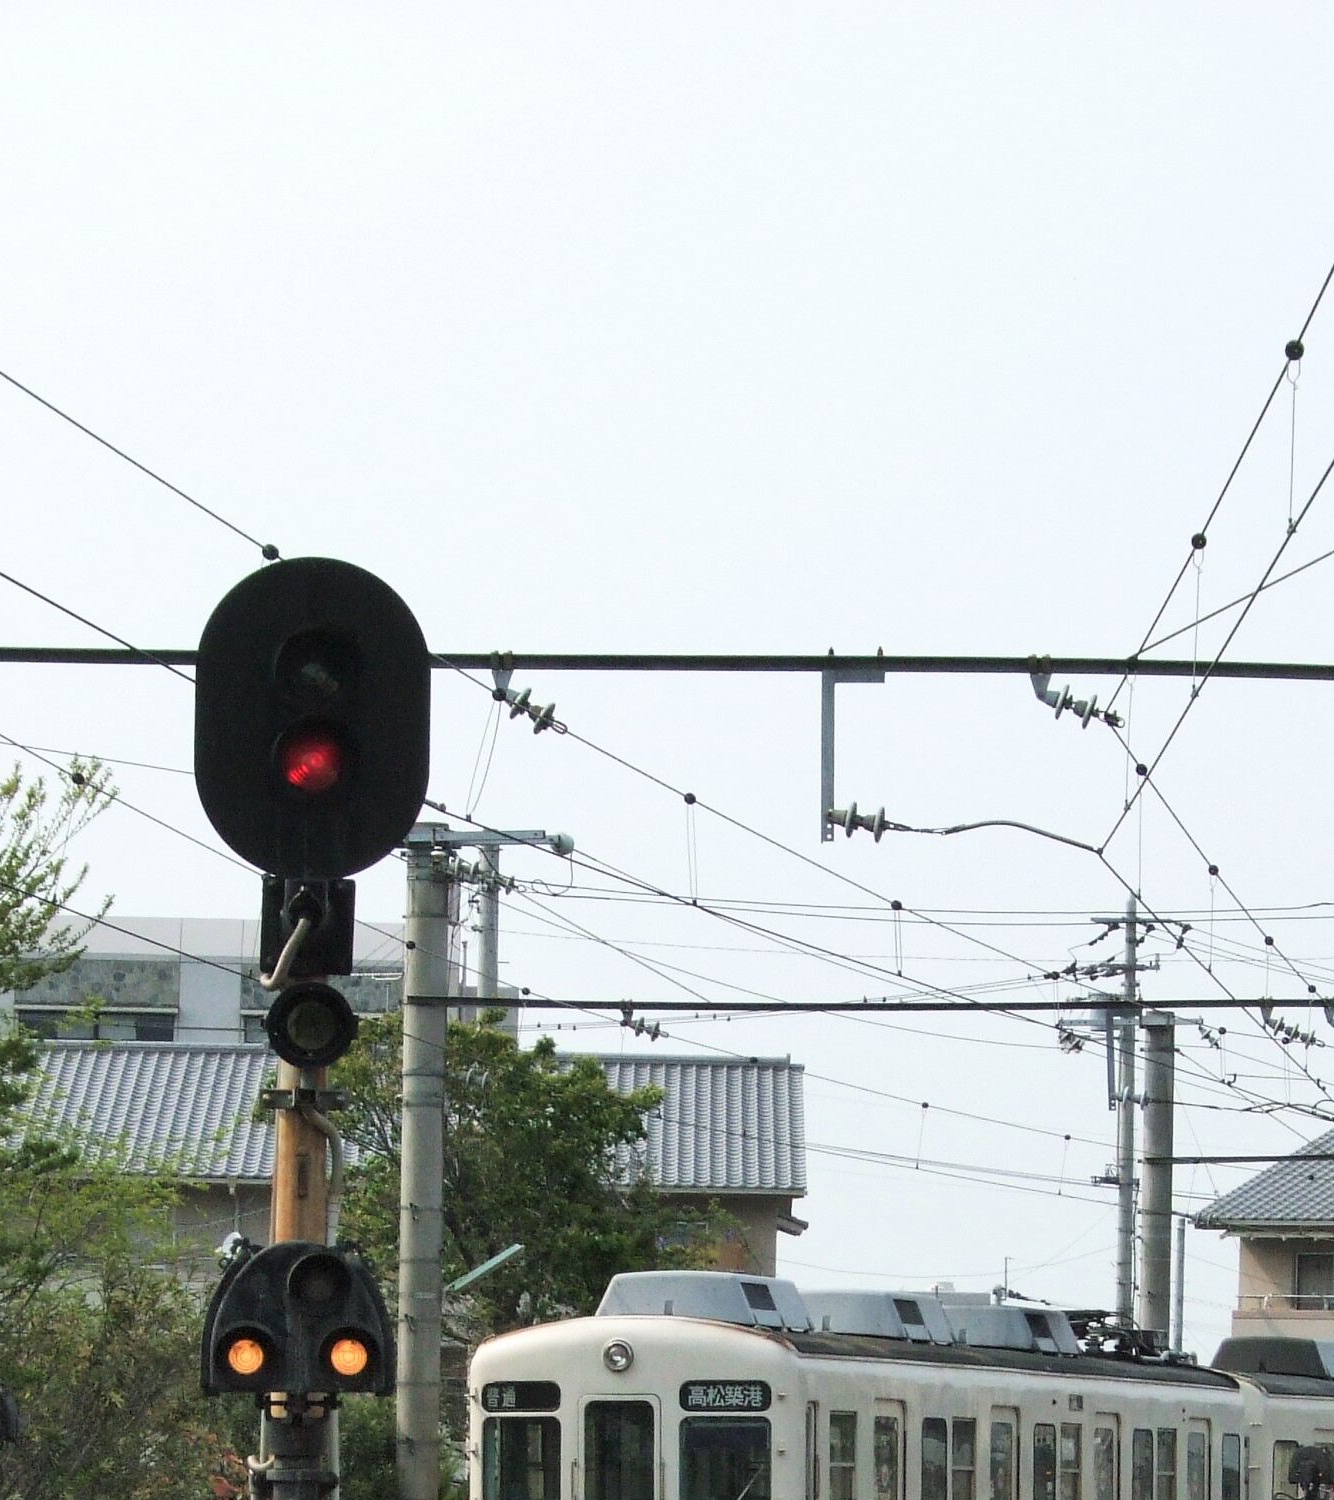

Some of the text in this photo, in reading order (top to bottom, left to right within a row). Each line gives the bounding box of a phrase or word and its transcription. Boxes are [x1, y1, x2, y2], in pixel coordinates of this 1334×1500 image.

[486, 1385, 516, 1407] 普通
[688, 1384, 763, 1407] 高松築港
